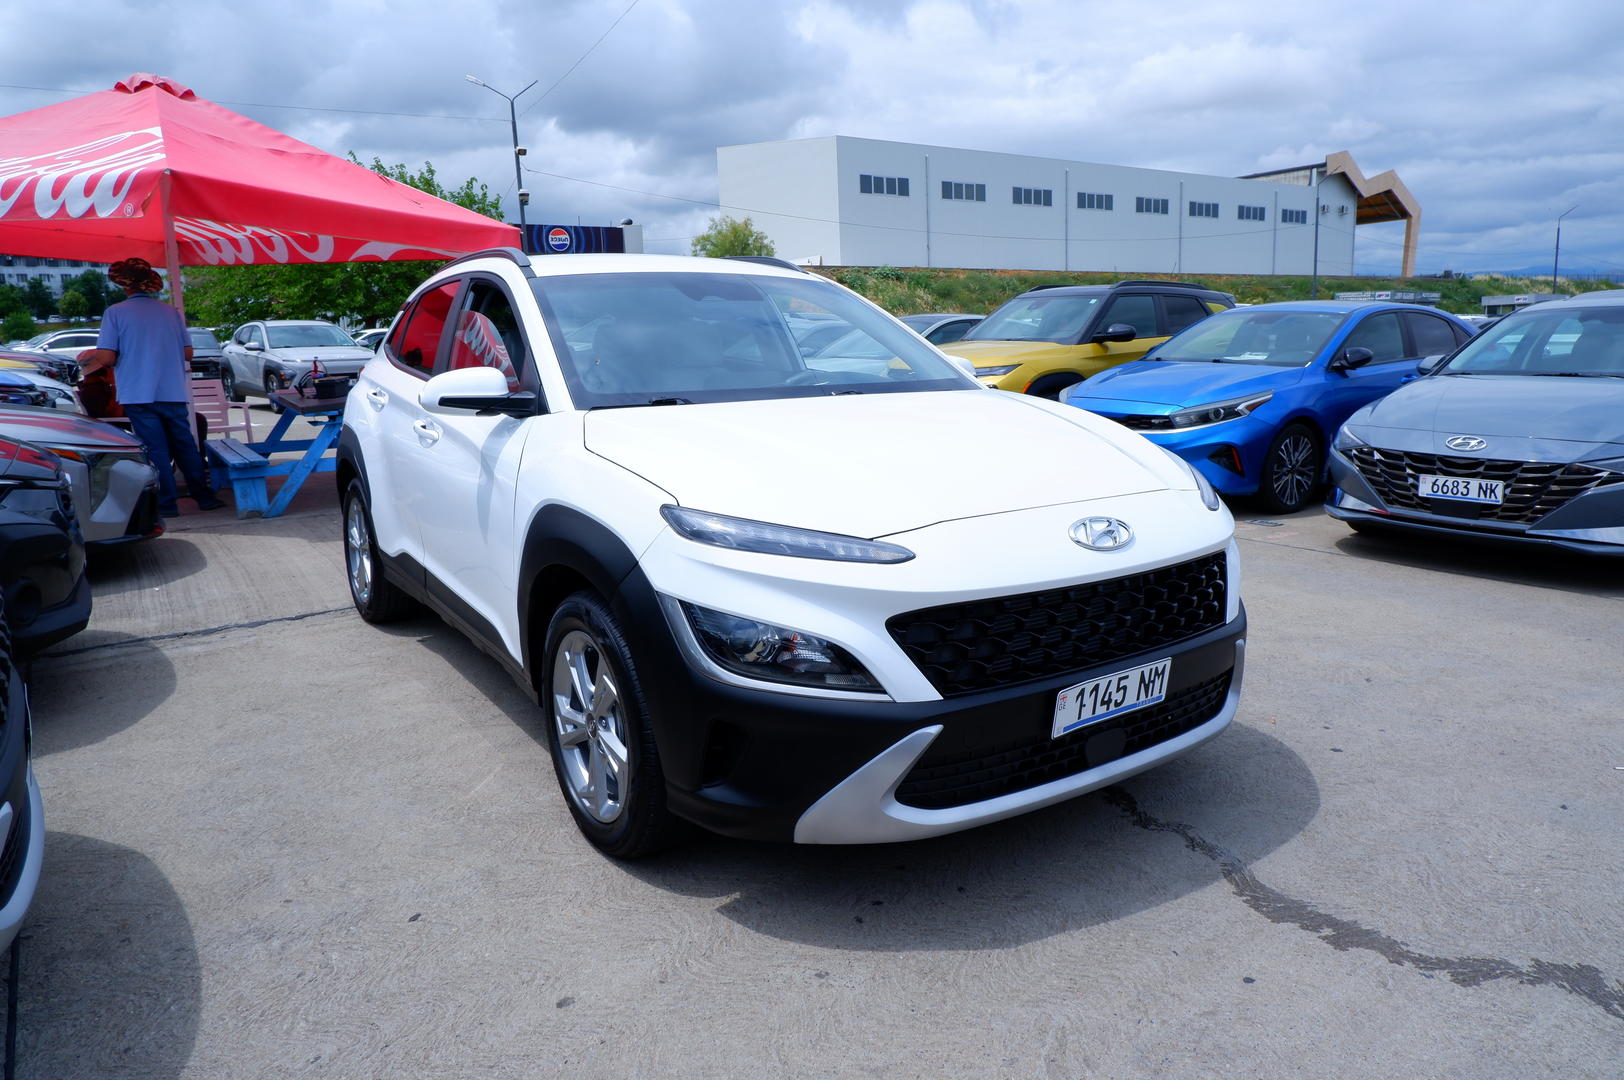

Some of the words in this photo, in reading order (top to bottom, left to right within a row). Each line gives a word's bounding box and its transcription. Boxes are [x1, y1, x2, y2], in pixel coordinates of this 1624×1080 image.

[1431, 478, 1470, 497] 6683
[1477, 482, 1500, 500] NK
[1075, 674, 1130, 720] 1145
[1136, 663, 1167, 702] NM
